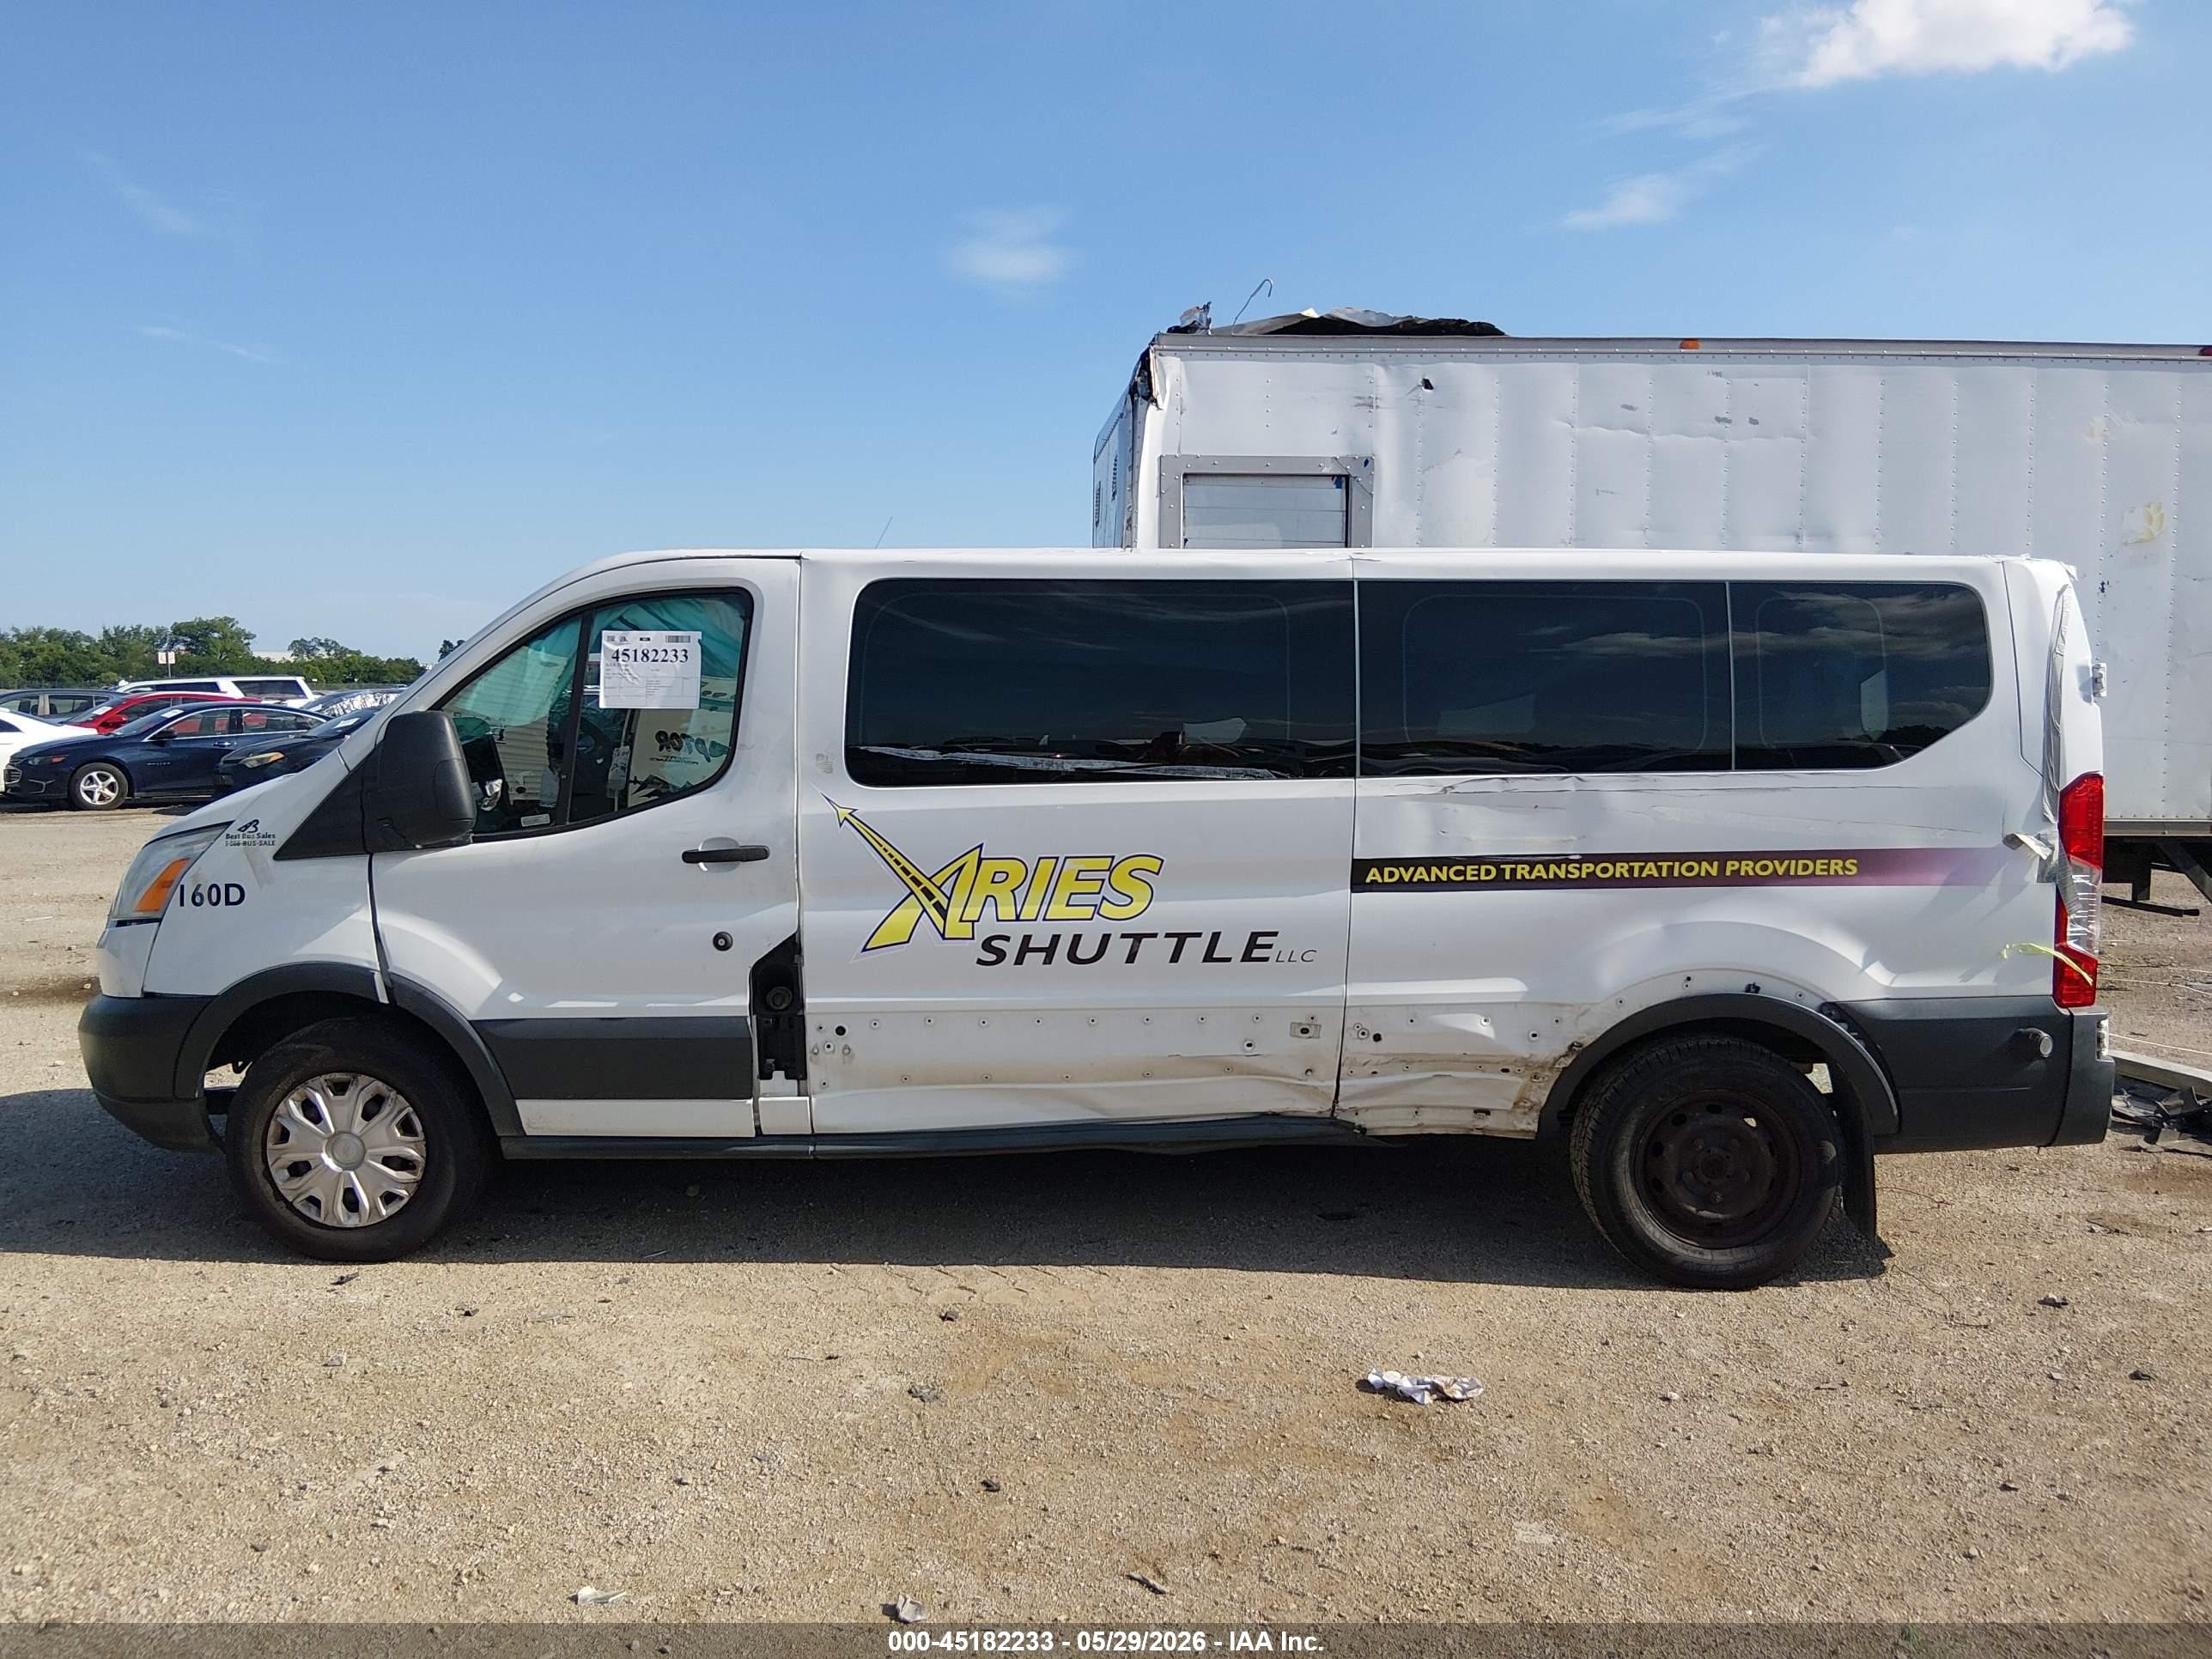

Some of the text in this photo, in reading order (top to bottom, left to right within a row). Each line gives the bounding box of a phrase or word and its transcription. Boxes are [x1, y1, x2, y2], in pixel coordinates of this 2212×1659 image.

[611, 648, 689, 663] 45182233
[1365, 859, 1857, 884] ADVANCED TRANSPORTATION PROVIDERS
[862, 843, 1164, 951] ARIES
[975, 931, 1316, 967] SHUTTLE LLC
